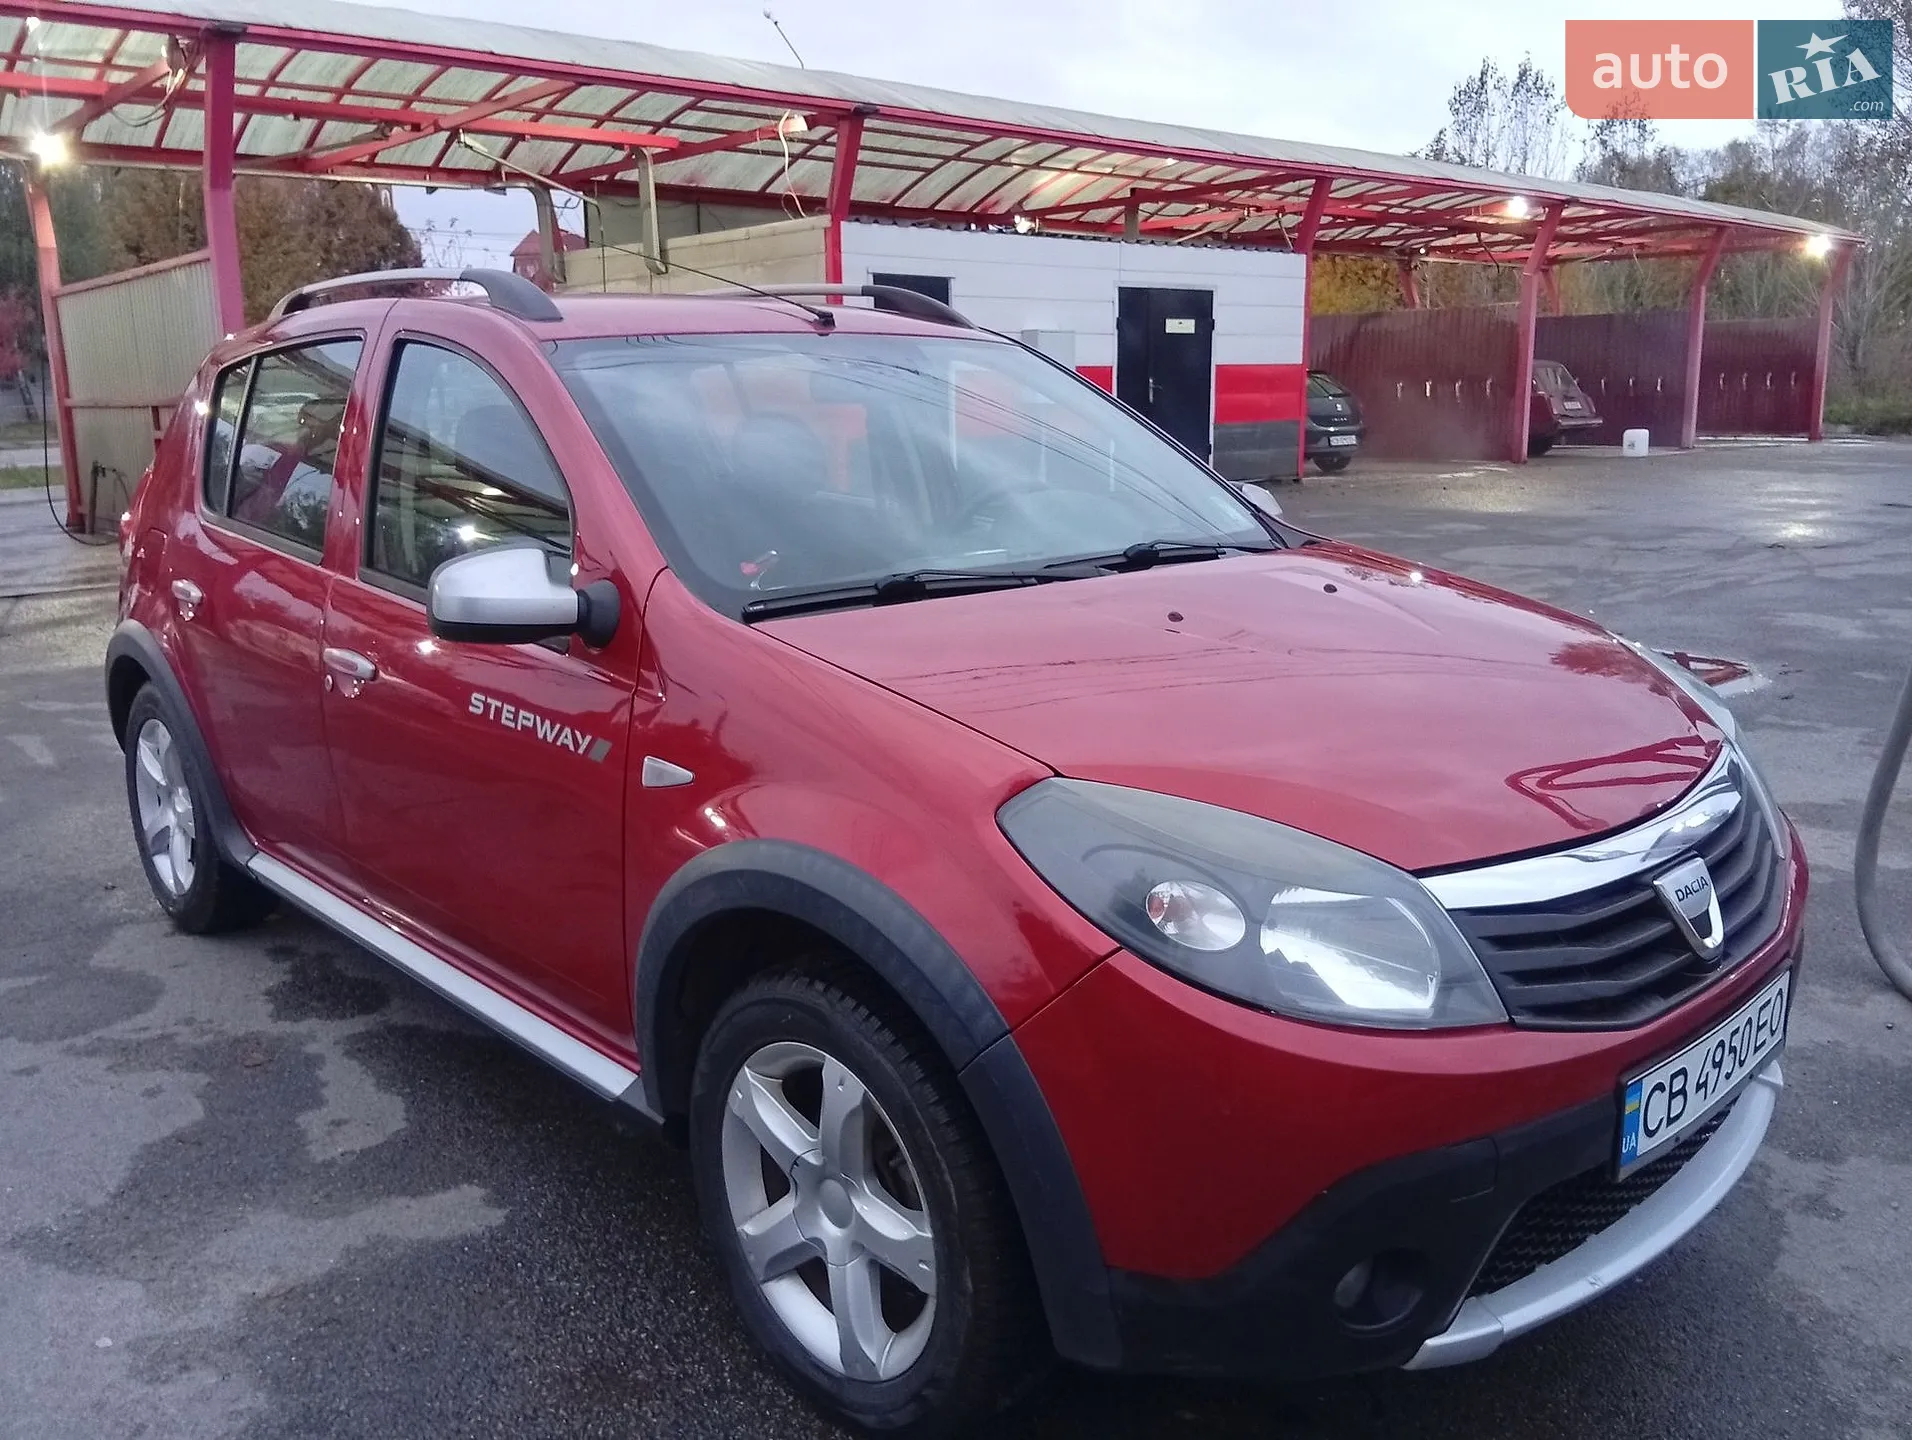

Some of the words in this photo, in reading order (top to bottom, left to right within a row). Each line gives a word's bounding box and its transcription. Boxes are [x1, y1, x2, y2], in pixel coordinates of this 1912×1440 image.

[468, 692, 592, 754] STEPWAY
[1674, 875, 1709, 903] DACIA
[1621, 1132, 1637, 1154] UA
